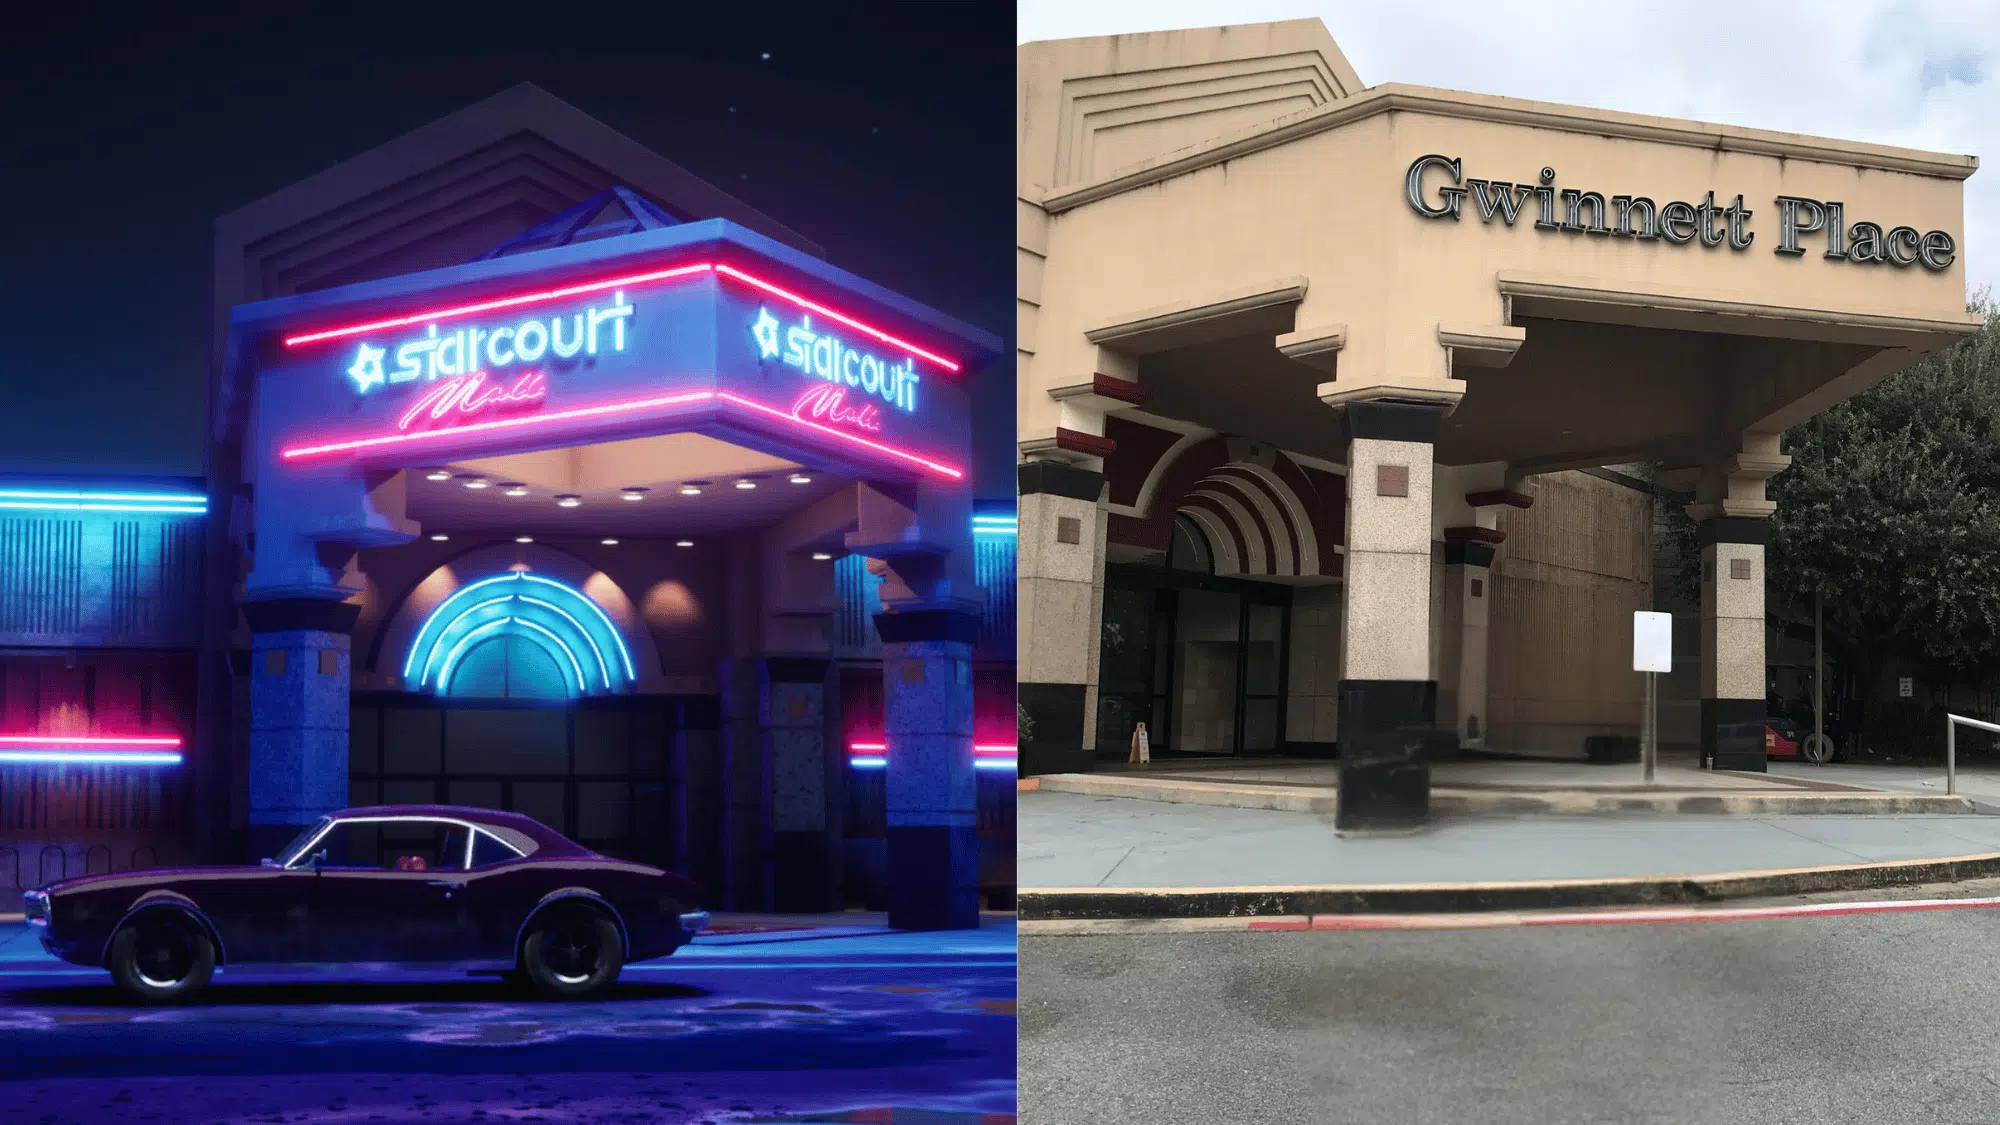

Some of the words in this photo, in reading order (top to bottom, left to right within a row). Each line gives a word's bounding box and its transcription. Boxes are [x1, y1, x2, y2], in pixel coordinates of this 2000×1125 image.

[1405, 154, 1754, 252] Gwinnett
[1774, 194, 1956, 272] Place
[389, 291, 634, 384] starcourt
[783, 314, 920, 412] starcourt
